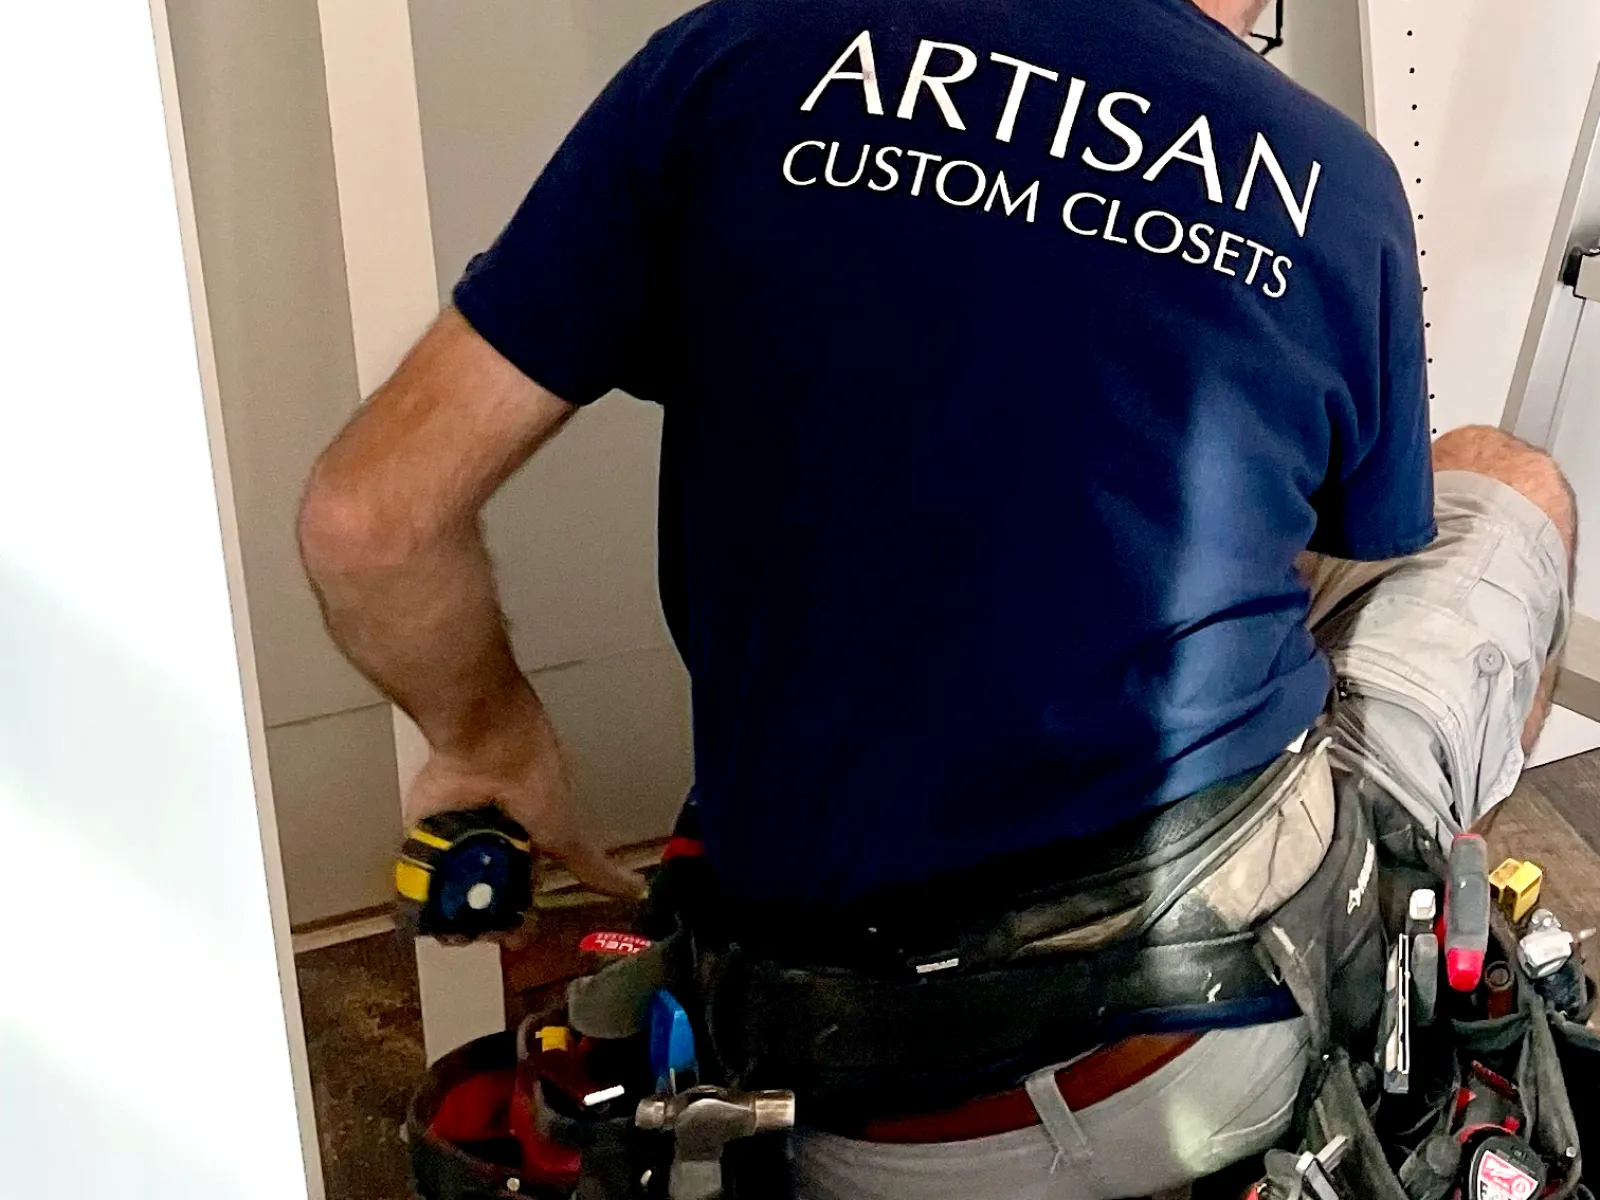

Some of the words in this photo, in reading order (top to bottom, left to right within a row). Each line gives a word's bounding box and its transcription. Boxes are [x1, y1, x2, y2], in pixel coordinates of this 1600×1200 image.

[782, 140, 1040, 223] CUSTOM
[1062, 192, 1293, 298] CLOSETS
[801, 30, 1322, 237] ARTISAN
